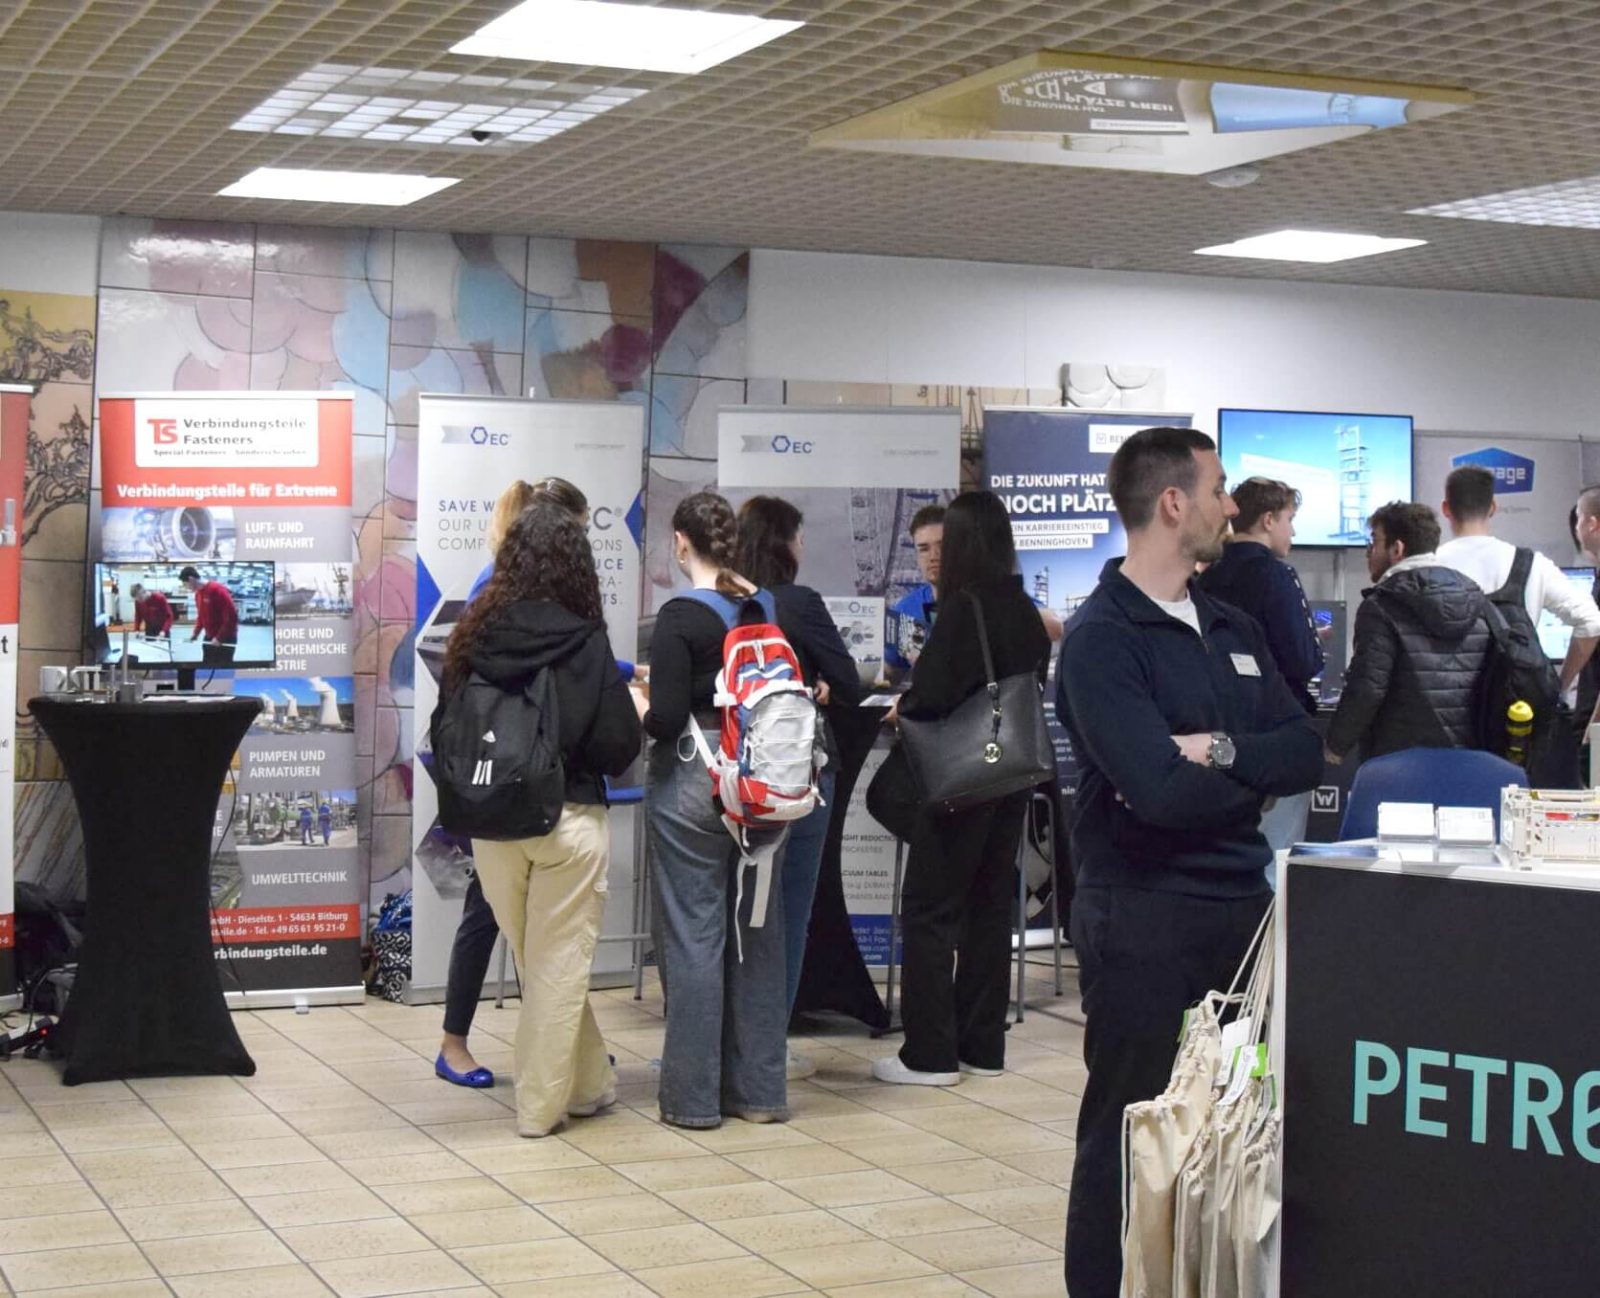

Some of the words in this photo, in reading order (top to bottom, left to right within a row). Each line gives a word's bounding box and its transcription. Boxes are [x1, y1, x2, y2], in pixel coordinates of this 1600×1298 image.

[183, 418, 306, 430] Verbindungsteile
[183, 434, 253, 444] Fasteners
[991, 475, 1014, 488] DIE
[1016, 474, 1078, 487] ZUKUNFT
[1081, 473, 1106, 486] HAT
[1496, 467, 1526, 485] age
[117, 483, 246, 500] Verbindungsteile
[249, 483, 272, 497] für
[275, 483, 337, 497] Extreme
[439, 499, 477, 512] SAVE
[483, 500, 496, 512] W
[1061, 488, 1117, 512] PLÄTZ
[245, 521, 275, 533] LUFT-
[278, 521, 304, 532] UND
[438, 518, 471, 531] OUR
[478, 518, 488, 532] U
[1026, 522, 1103, 532] KARRIEREEINSTIEG
[245, 537, 315, 549] RAUMFAHRT
[438, 537, 486, 551] COMP
[592, 539, 623, 551] ONS
[1019, 537, 1089, 547] BENNINGHOVEN
[594, 558, 624, 570] UCE
[275, 628, 305, 639] HORE
[308, 628, 334, 639] UND
[276, 643, 347, 655] OCHEMISCHE
[249, 750, 297, 762] PUMPEN
[300, 750, 326, 761] UND
[250, 766, 320, 778] ARMATUREN
[251, 871, 348, 885] UMWELTTECHNIK
[318, 911, 349, 922] Bitburg
[214, 944, 328, 960] rbindungsteile.de
